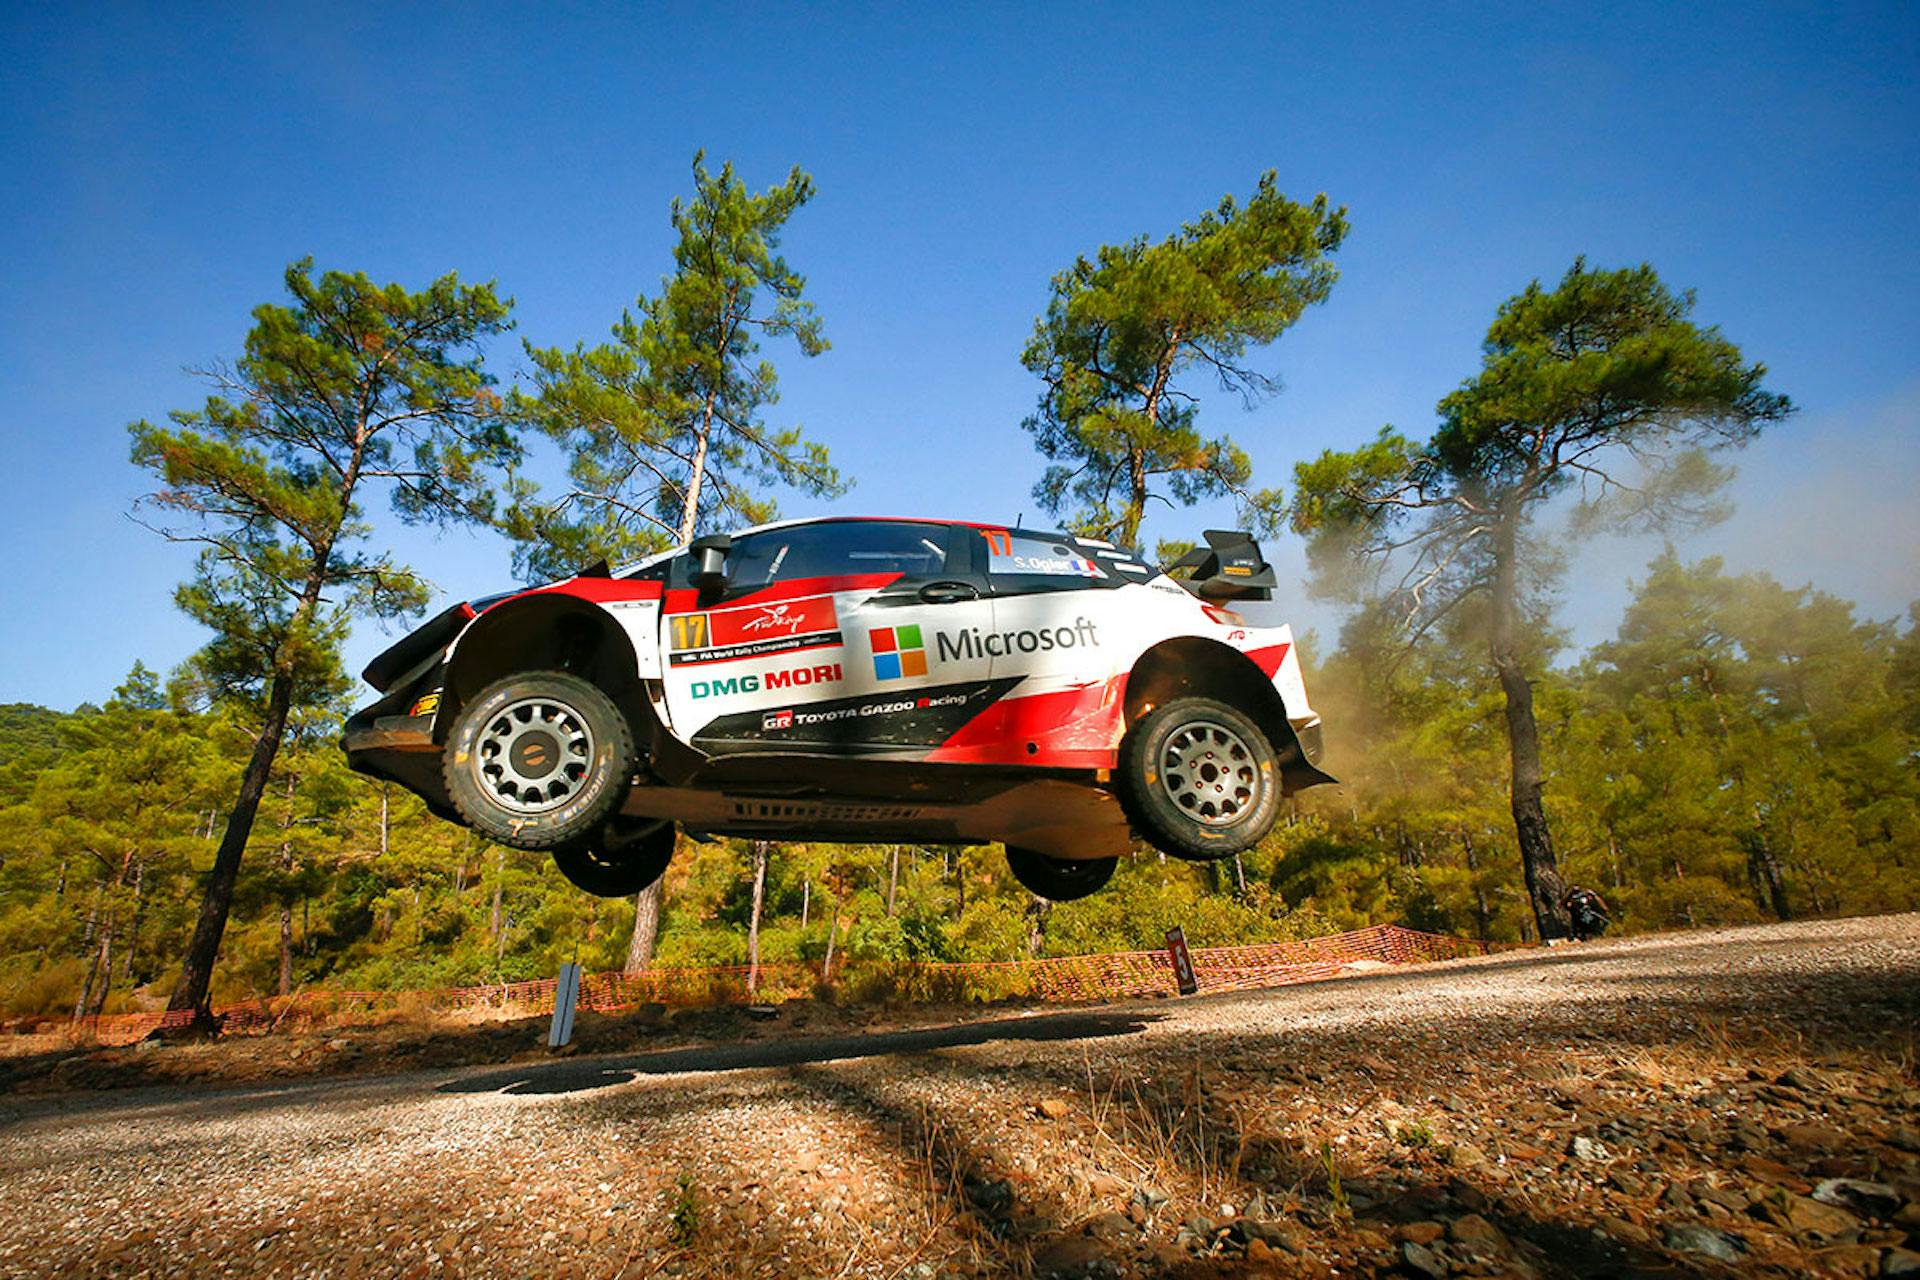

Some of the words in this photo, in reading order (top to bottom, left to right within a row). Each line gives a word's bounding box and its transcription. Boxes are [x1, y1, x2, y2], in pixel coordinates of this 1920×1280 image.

[979, 529, 1012, 556] 17
[673, 614, 705, 649] 17
[753, 640, 799, 654] Championship
[936, 616, 1100, 663] Microsoft
[691, 675, 759, 699] DMG
[764, 663, 843, 691] MORI
[763, 717, 792, 731] GR
[795, 709, 857, 725] TOYOTA
[859, 701, 914, 716] GAZOO
[917, 694, 967, 709] Racing
